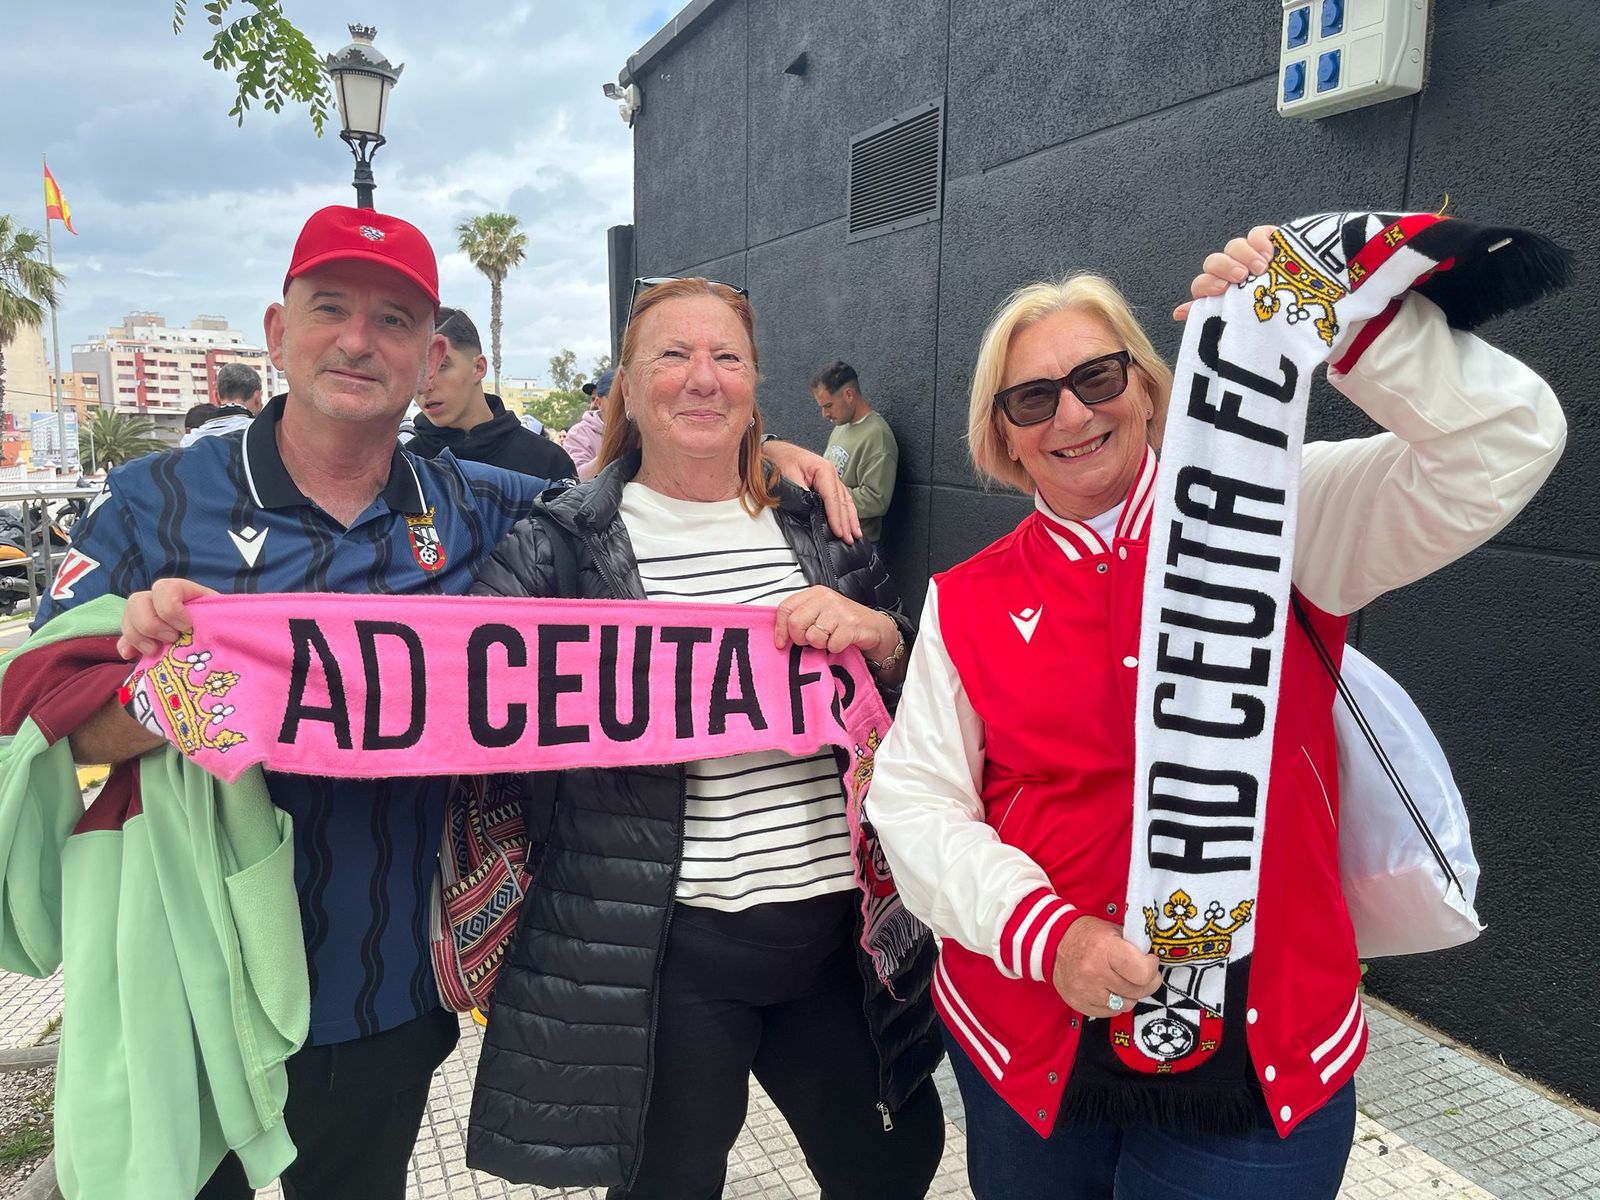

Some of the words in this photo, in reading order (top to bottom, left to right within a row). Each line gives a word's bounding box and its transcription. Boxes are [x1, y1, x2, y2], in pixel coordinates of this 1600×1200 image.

[1187, 315, 1299, 451] FC
[1153, 465, 1286, 740] CEUTA
[278, 618, 427, 751] AD
[466, 623, 769, 749] CEUTA
[1148, 761, 1258, 875] AD
